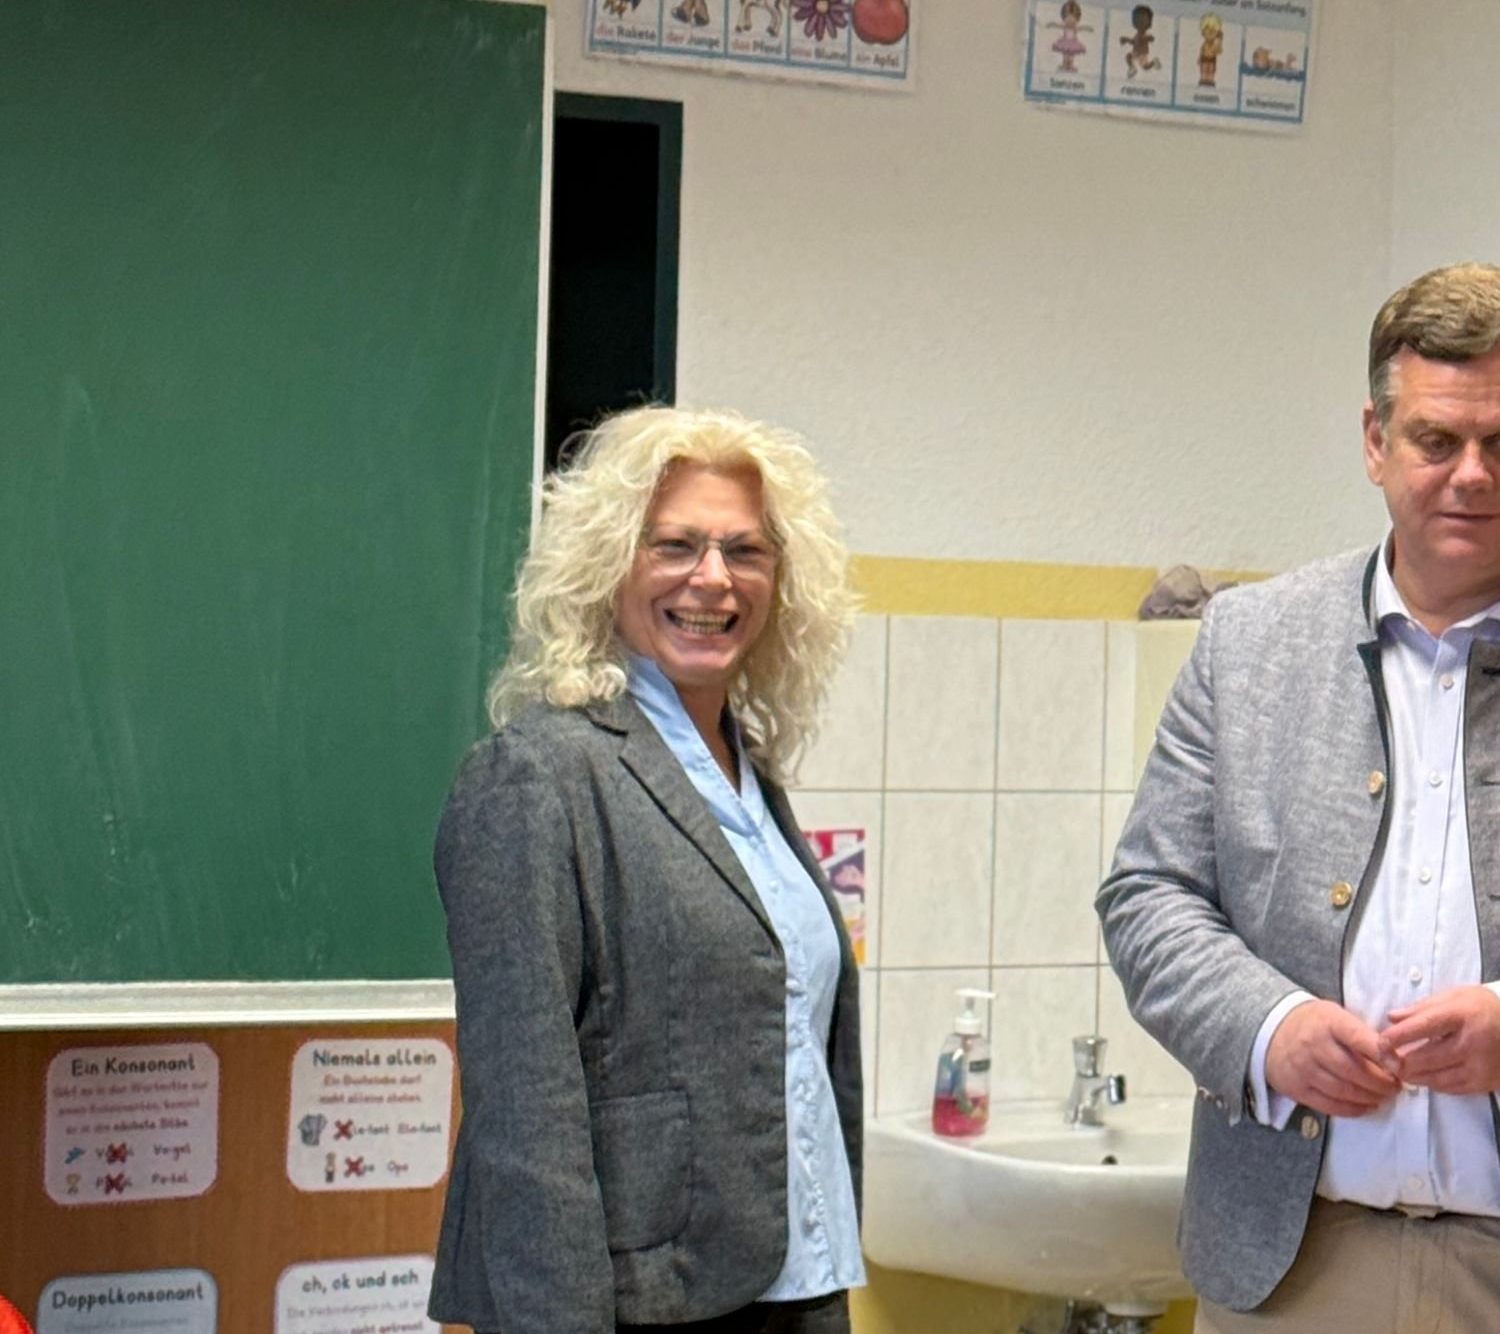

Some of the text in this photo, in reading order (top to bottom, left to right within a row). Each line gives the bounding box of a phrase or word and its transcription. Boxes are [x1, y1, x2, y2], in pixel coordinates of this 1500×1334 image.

[71, 1053, 196, 1077] Ein Konsonant
[313, 1048, 437, 1068] Niemals allein
[302, 1268, 419, 1294] ch, ck und sch
[52, 1283, 204, 1313] Doppelkonsonant
